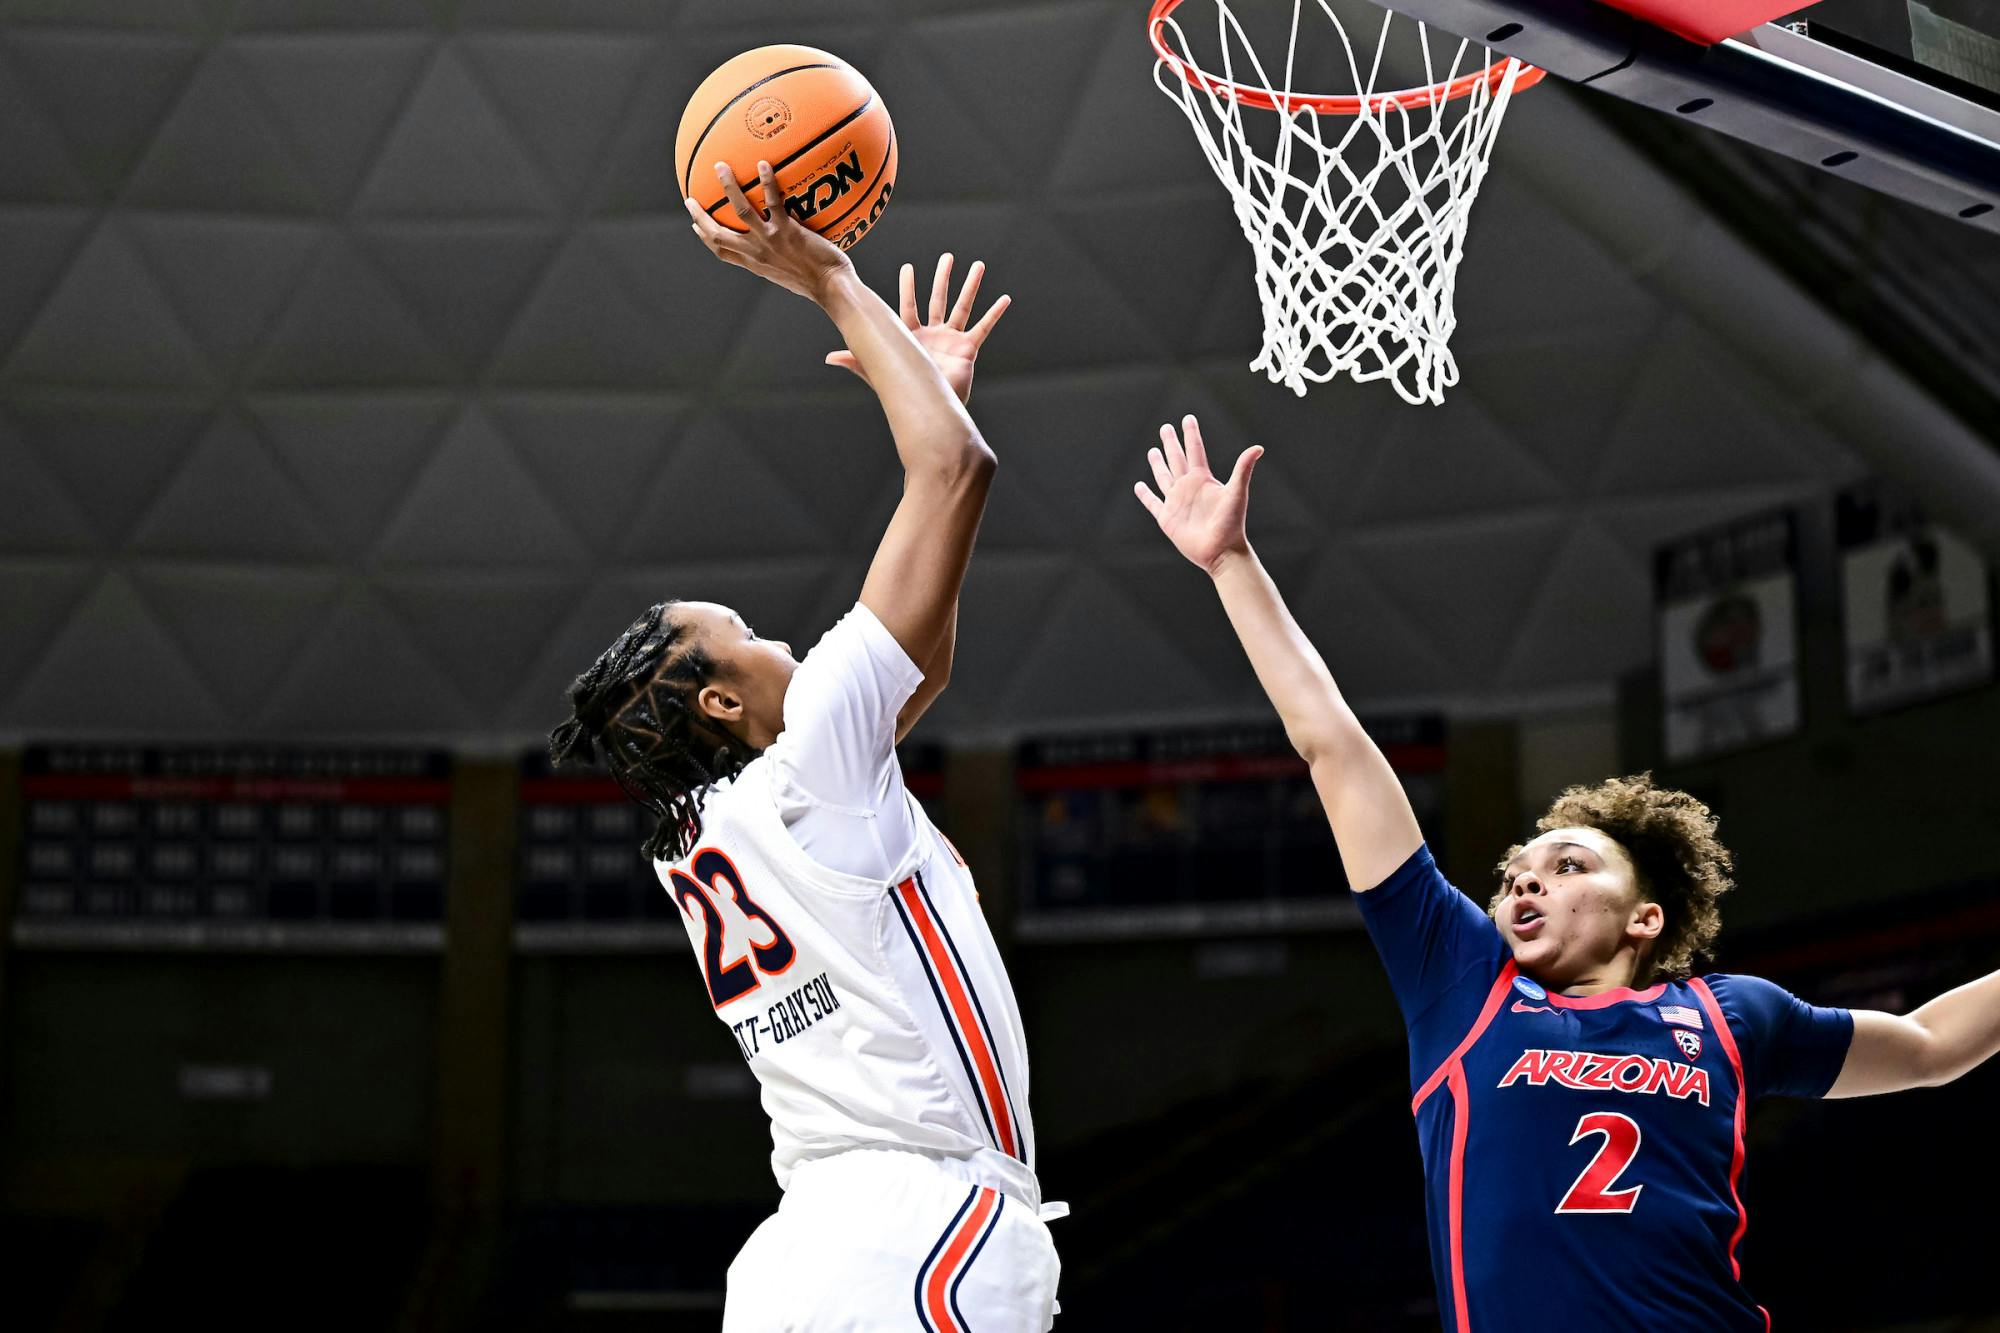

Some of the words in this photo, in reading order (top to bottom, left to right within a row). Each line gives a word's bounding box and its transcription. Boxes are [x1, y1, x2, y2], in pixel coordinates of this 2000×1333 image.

[668, 847, 797, 1011] 23
[1497, 1049, 1710, 1107] ARIZONA
[1554, 1111, 1644, 1215] 2
